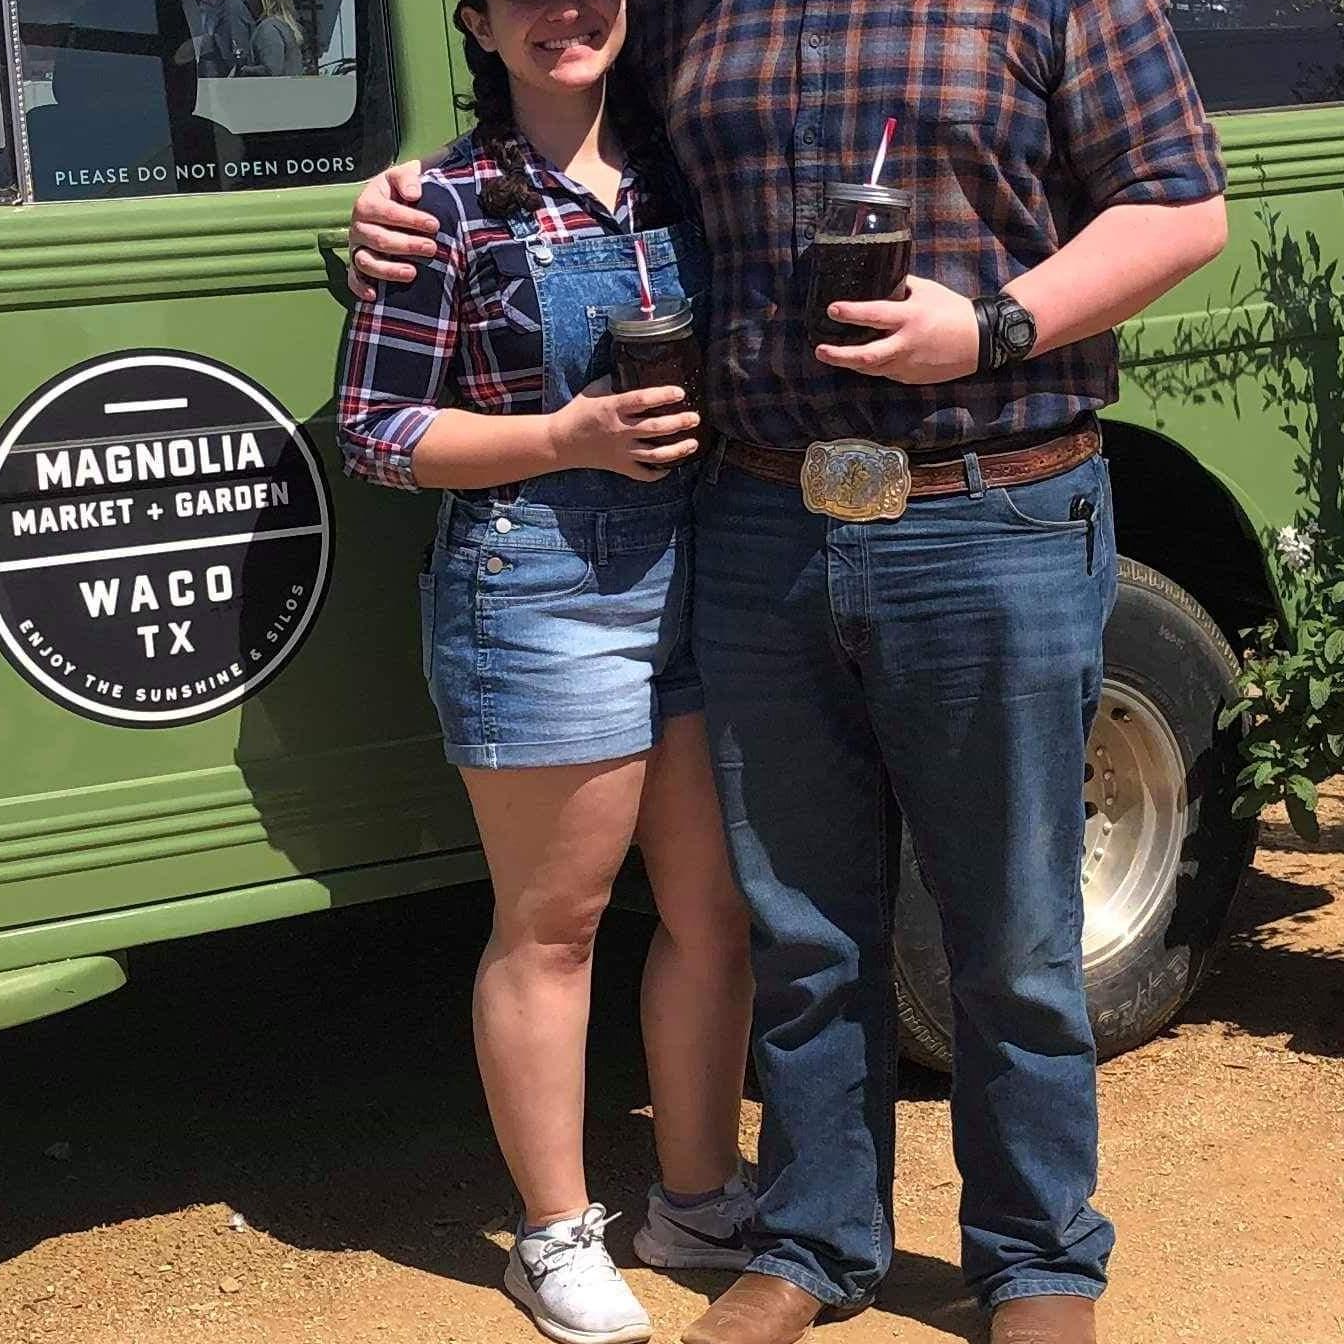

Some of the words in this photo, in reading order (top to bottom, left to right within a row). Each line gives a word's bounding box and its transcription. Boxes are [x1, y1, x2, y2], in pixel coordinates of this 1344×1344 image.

[56, 167, 128, 186] PLEASE
[138, 166, 167, 182] DO
[176, 163, 217, 180] NOT
[224, 160, 278, 177] OPEN
[287, 156, 354, 174] DOORS
[36, 432, 264, 490] MAGNOLIA
[12, 498, 134, 536] MARKET
[175, 481, 289, 518] GARDEN
[79, 565, 233, 618] WACO
[19, 618, 78, 676] ENJOY
[84, 673, 124, 700] THE
[135, 661, 244, 703] SUNSHINE
[249, 647, 263, 662] &
[266, 583, 305, 644] SILOS
[136, 621, 195, 658] TX
